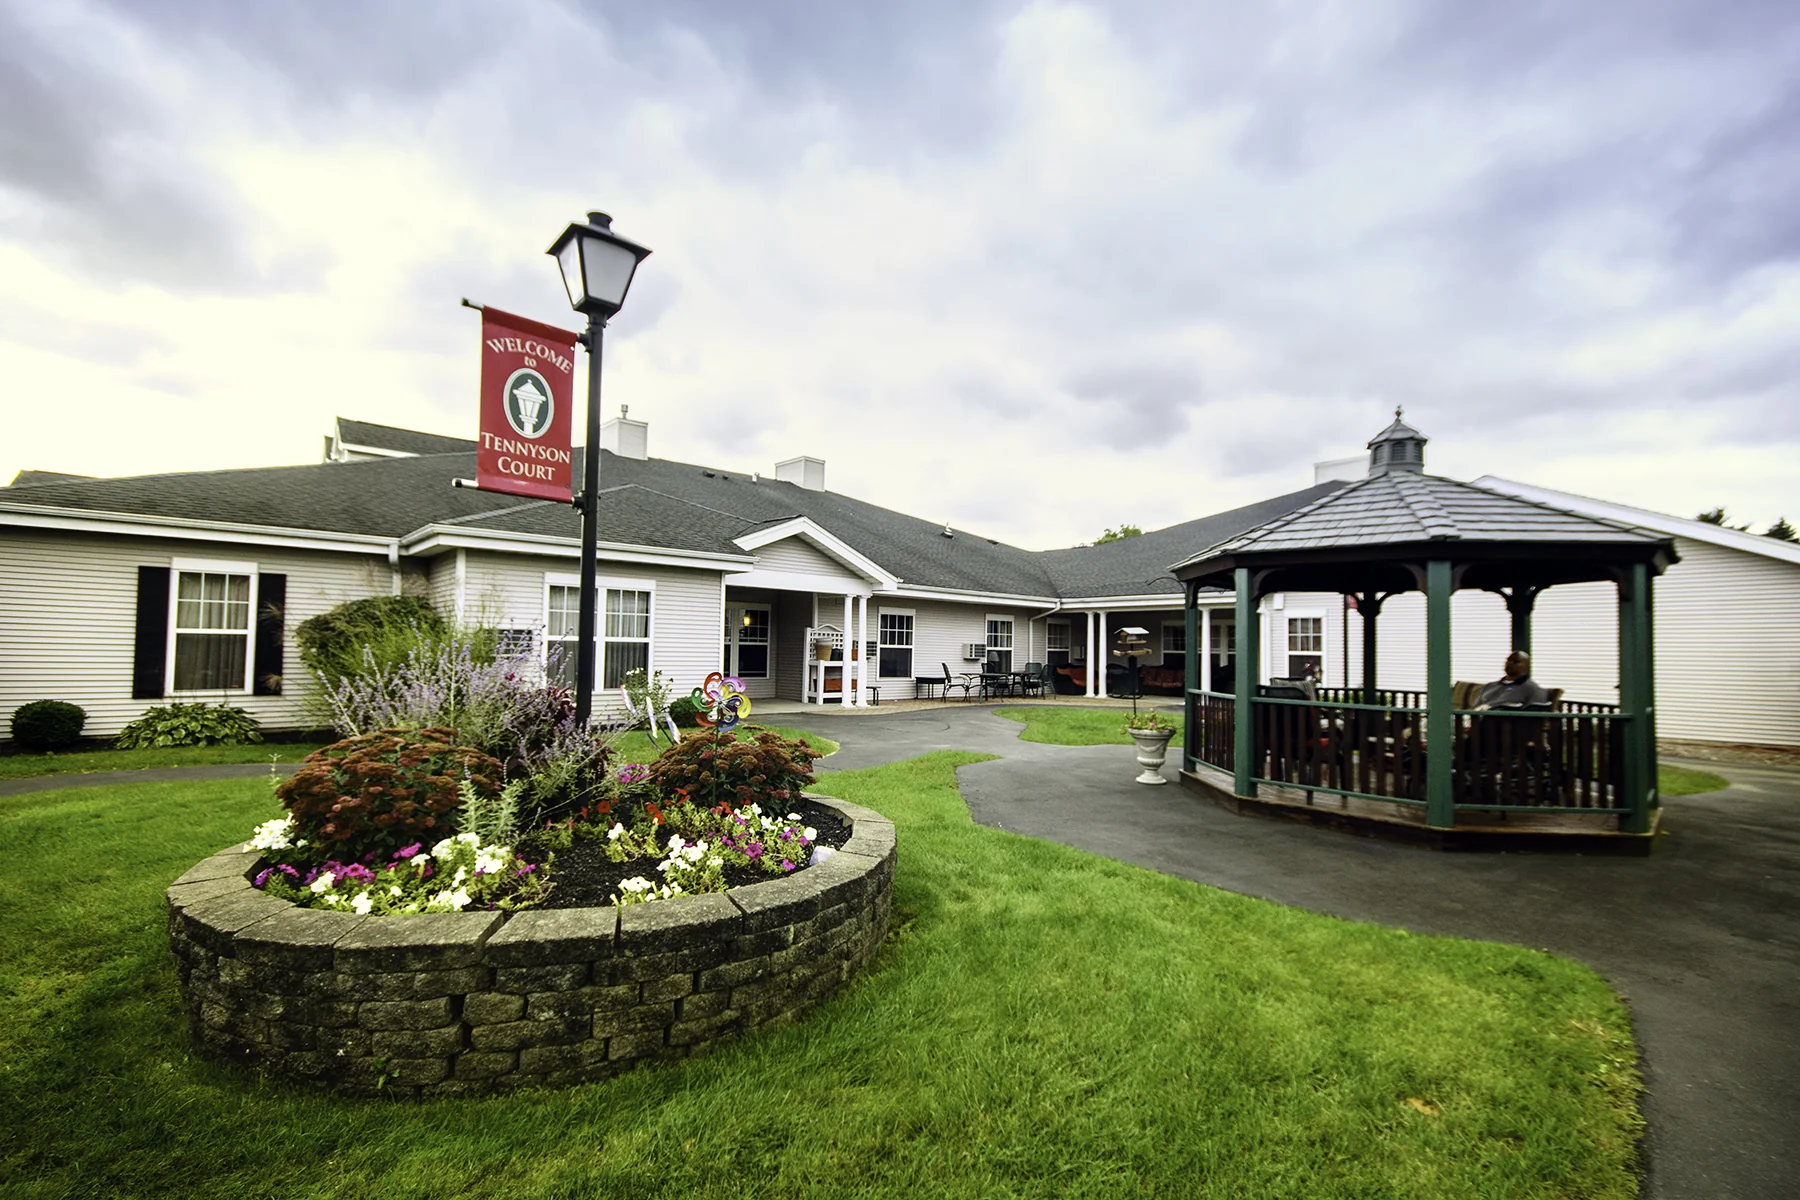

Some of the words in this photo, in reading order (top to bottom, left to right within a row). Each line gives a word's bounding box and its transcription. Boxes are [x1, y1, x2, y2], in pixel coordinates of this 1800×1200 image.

[486, 337, 573, 374] WELCOME
[524, 355, 537, 368] to
[481, 431, 571, 464] TENNYSON
[497, 456, 556, 481] COURT
